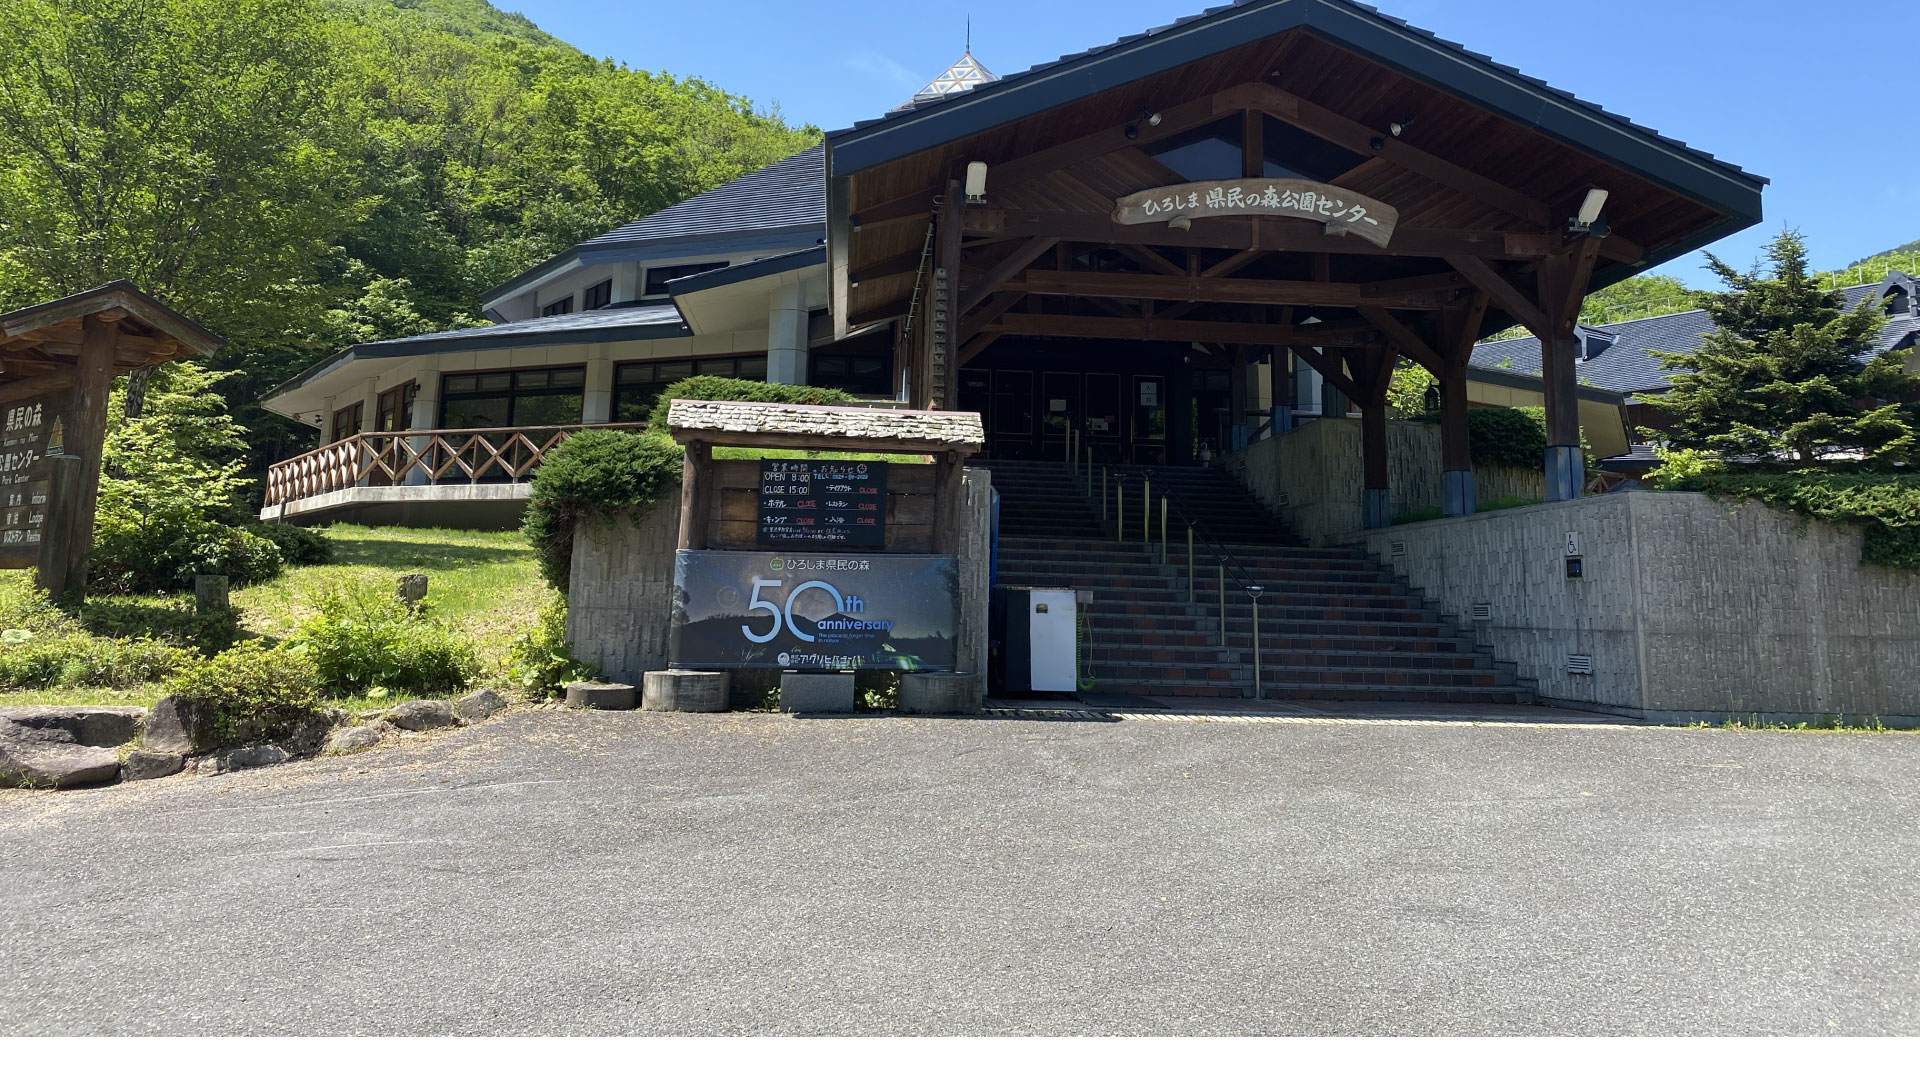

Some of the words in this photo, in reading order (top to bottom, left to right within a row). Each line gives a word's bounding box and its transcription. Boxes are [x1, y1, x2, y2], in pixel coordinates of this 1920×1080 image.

[5, 402, 43, 432] 県民の森
[2, 475, 12, 485] Park
[14, 473, 30, 484] Center
[764, 473, 786, 482] OPEN
[791, 473, 810, 483] 8:00
[764, 485, 785, 494] CLOSE
[789, 485, 808, 495] 15:00
[859, 486, 878, 495] CLOSE
[767, 499, 787, 508] ホテル
[797, 500, 817, 508] CLOSE
[828, 500, 849, 508] レストラン
[766, 515, 788, 524] キャンプ
[796, 517, 816, 525] CLOSE
[3, 529, 24, 544] レストラン
[785, 559, 871, 572] ひろしま県民の森
[817, 618, 894, 633] anniversary
